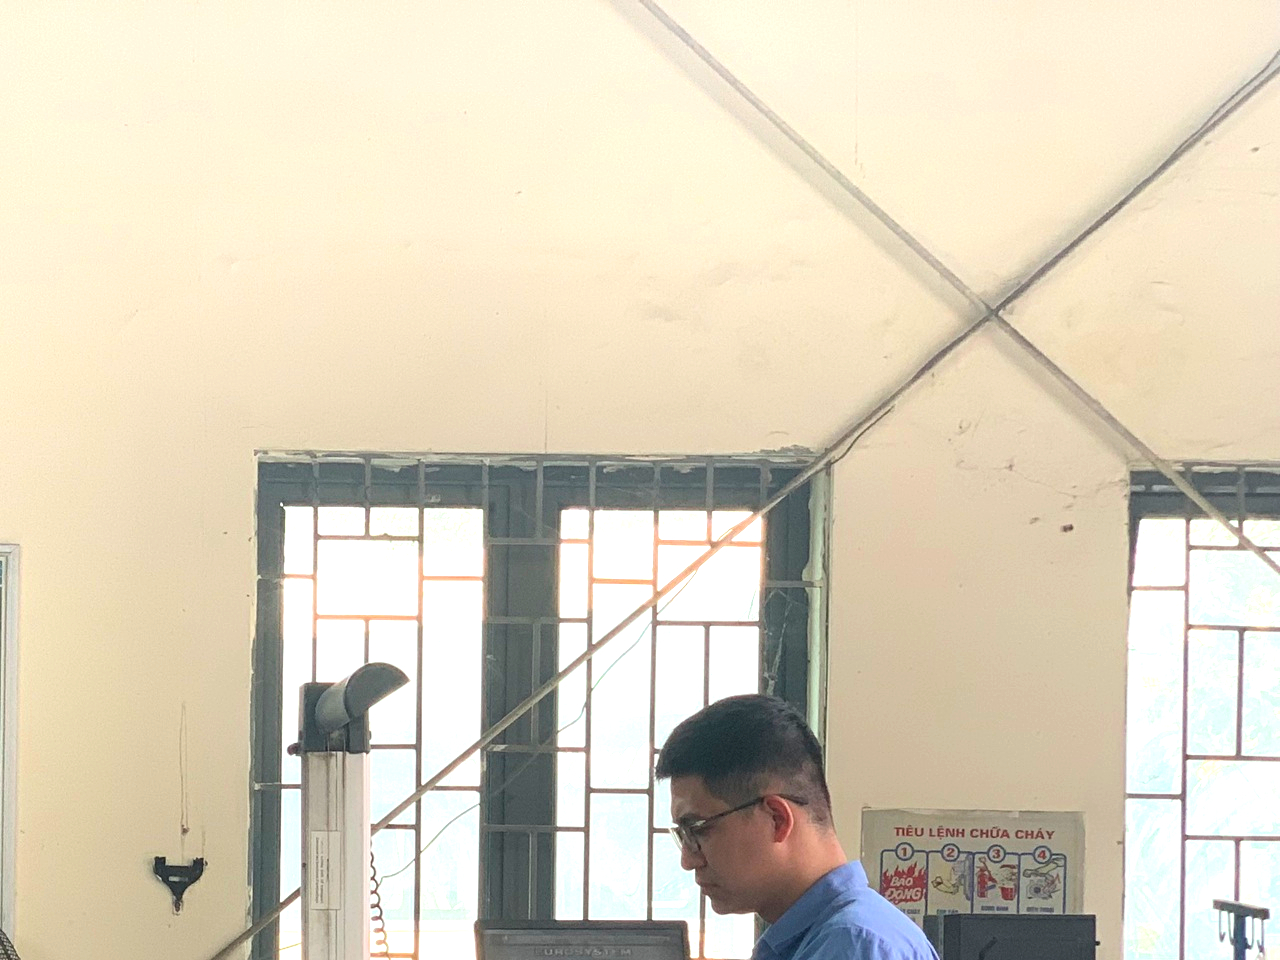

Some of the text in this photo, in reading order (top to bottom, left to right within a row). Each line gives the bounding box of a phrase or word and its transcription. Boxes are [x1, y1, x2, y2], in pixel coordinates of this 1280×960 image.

[894, 824, 1056, 841] TIÊU LỆNH CHỮA CHÁY
[901, 847, 908, 857] 1
[946, 847, 956, 858] 2
[992, 848, 1001, 859] 3
[1037, 849, 1047, 860] 4
